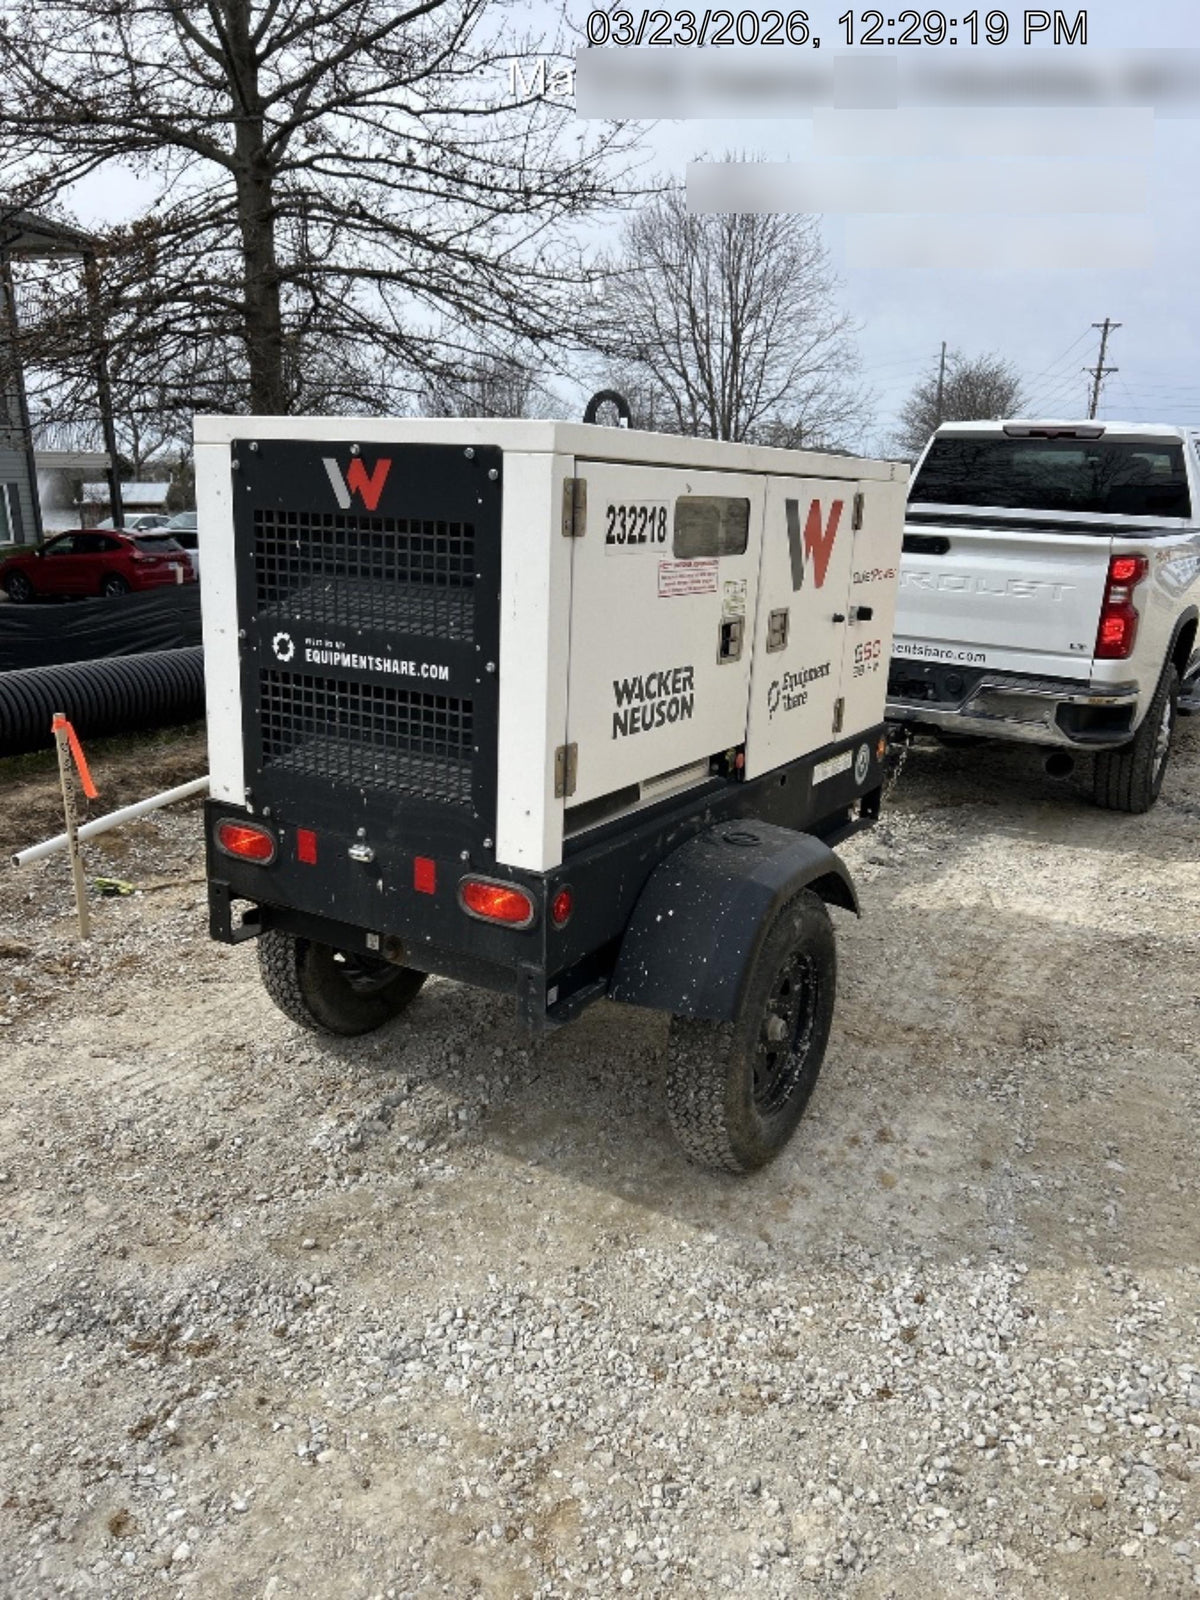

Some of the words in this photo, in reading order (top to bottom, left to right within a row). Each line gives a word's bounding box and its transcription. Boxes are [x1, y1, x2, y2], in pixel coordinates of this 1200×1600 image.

[605, 504, 668, 546] 232218
[305, 648, 449, 681] EQUIPMENTSHARE.COM
[891, 641, 986, 663] entshare.com
[613, 666, 694, 707] WACKER
[612, 694, 694, 740] NEUSON
